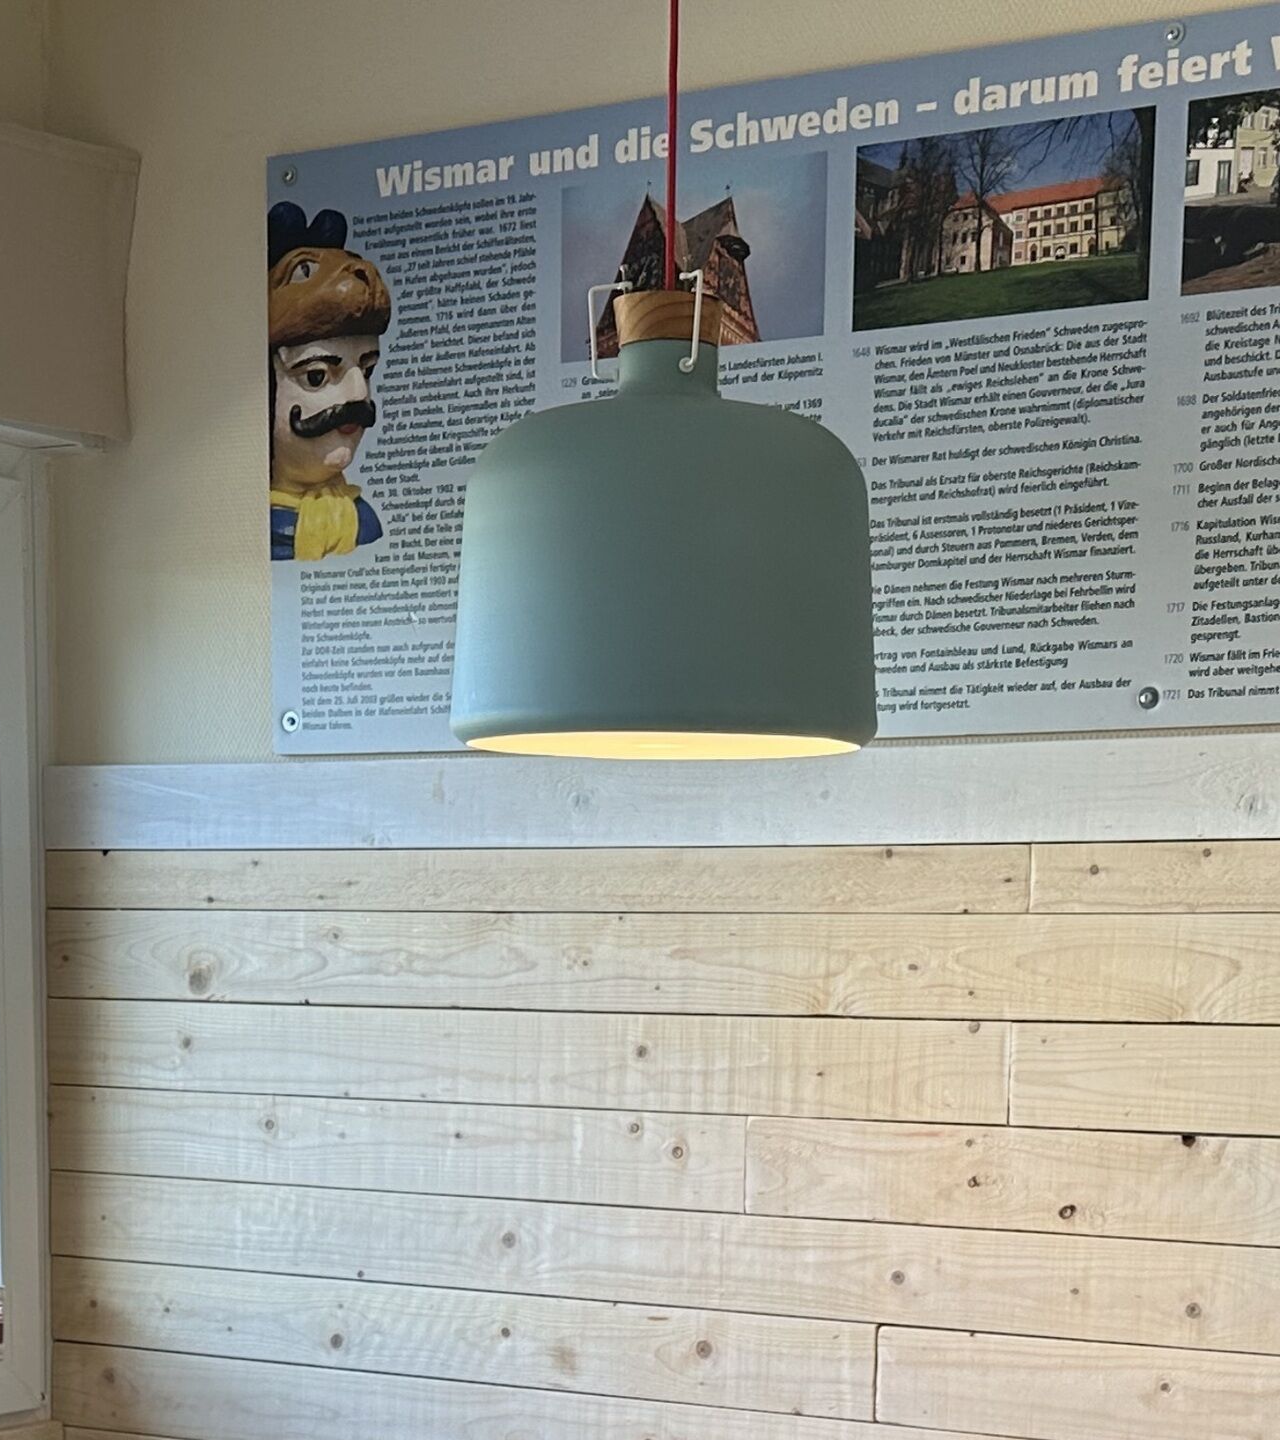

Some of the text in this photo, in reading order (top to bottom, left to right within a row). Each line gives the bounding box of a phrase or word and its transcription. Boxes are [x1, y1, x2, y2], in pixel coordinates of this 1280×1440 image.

[377, 157, 513, 197] Wismar
[529, 137, 598, 176] und
[616, 131, 669, 169] die
[690, 98, 900, 153] Schweden
[954, 70, 1099, 116] darum
[1117, 46, 1253, 92] feiert
